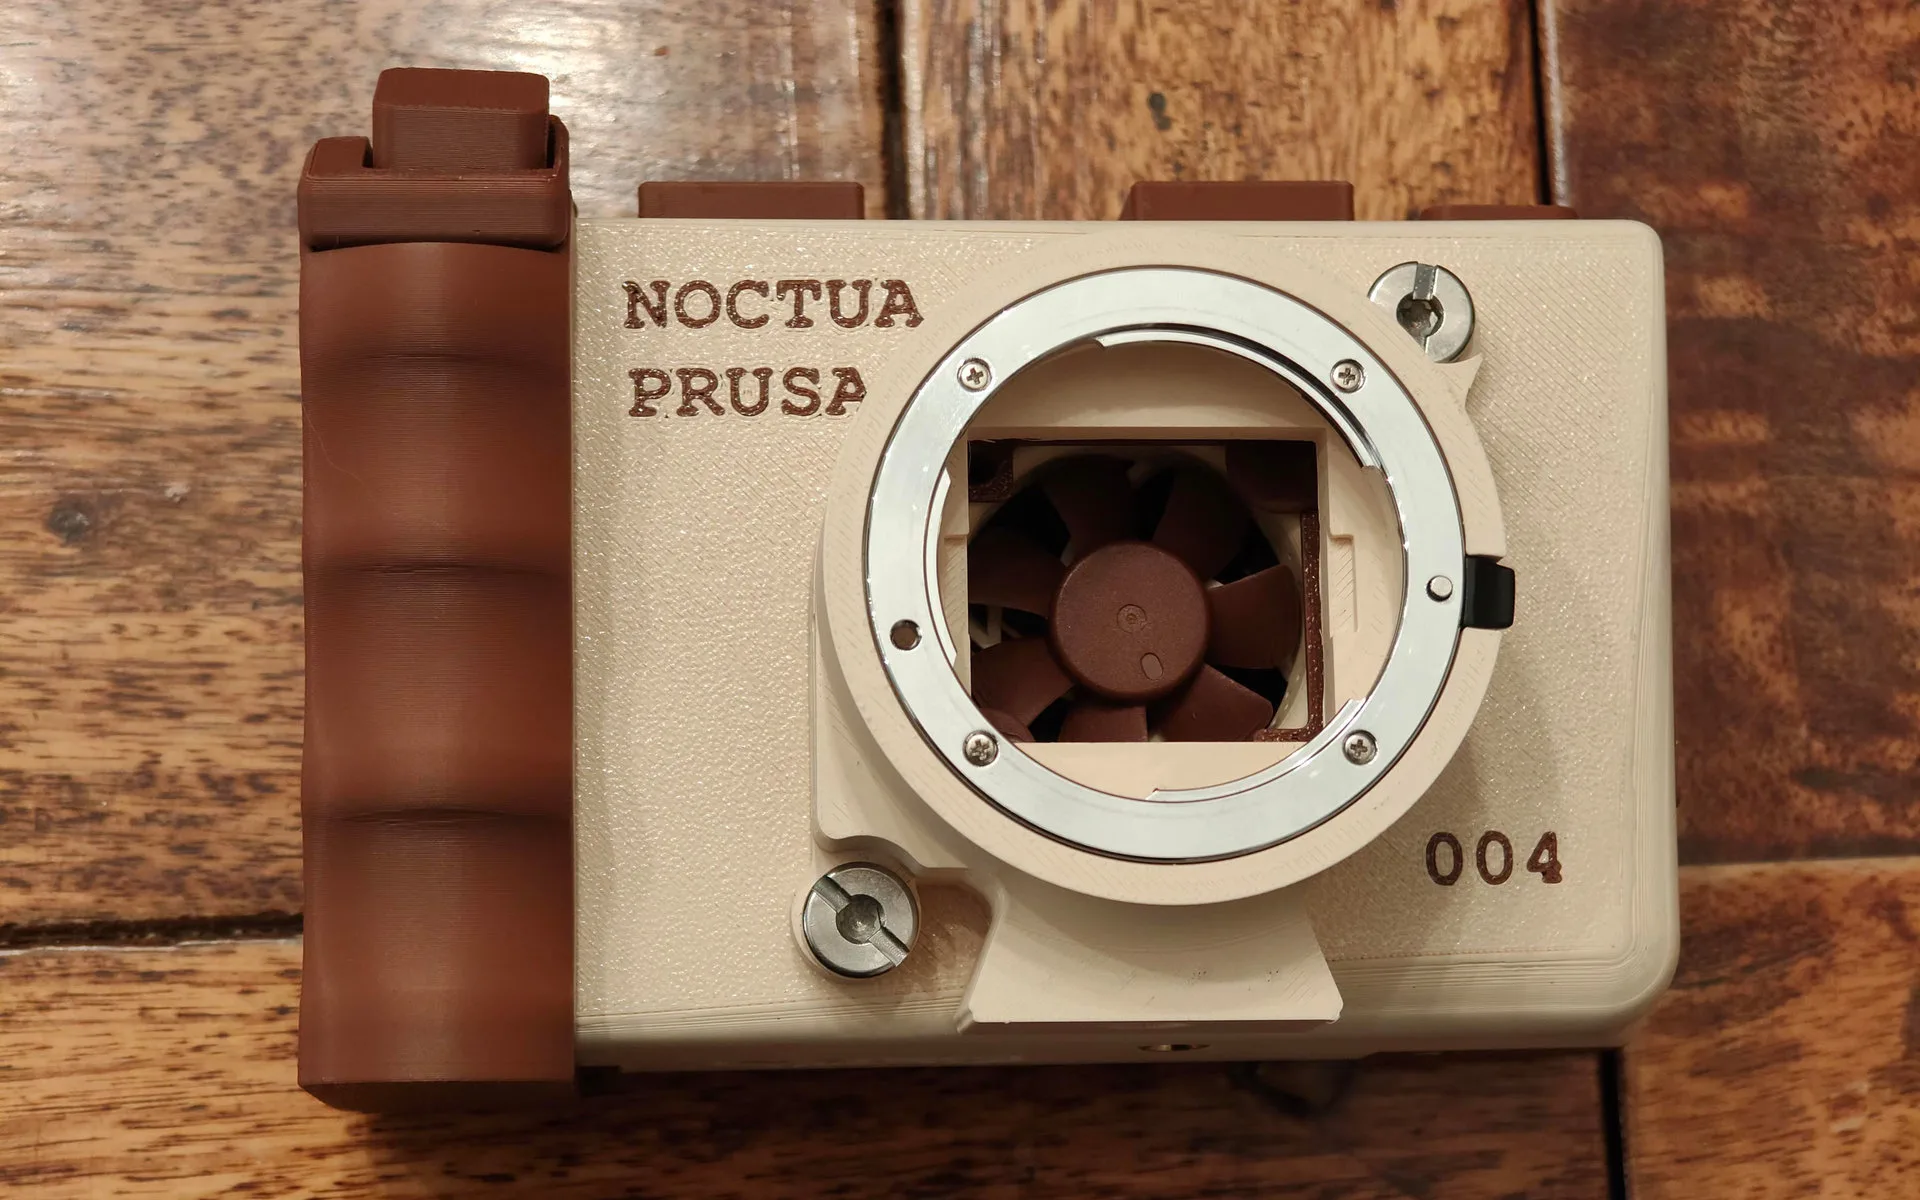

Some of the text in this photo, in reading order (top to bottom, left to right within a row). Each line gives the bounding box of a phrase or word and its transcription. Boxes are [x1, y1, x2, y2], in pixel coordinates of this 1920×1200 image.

[622, 280, 924, 329] NOCTUA
[628, 367, 867, 416] PRUSA
[1426, 830, 1562, 886] 004
